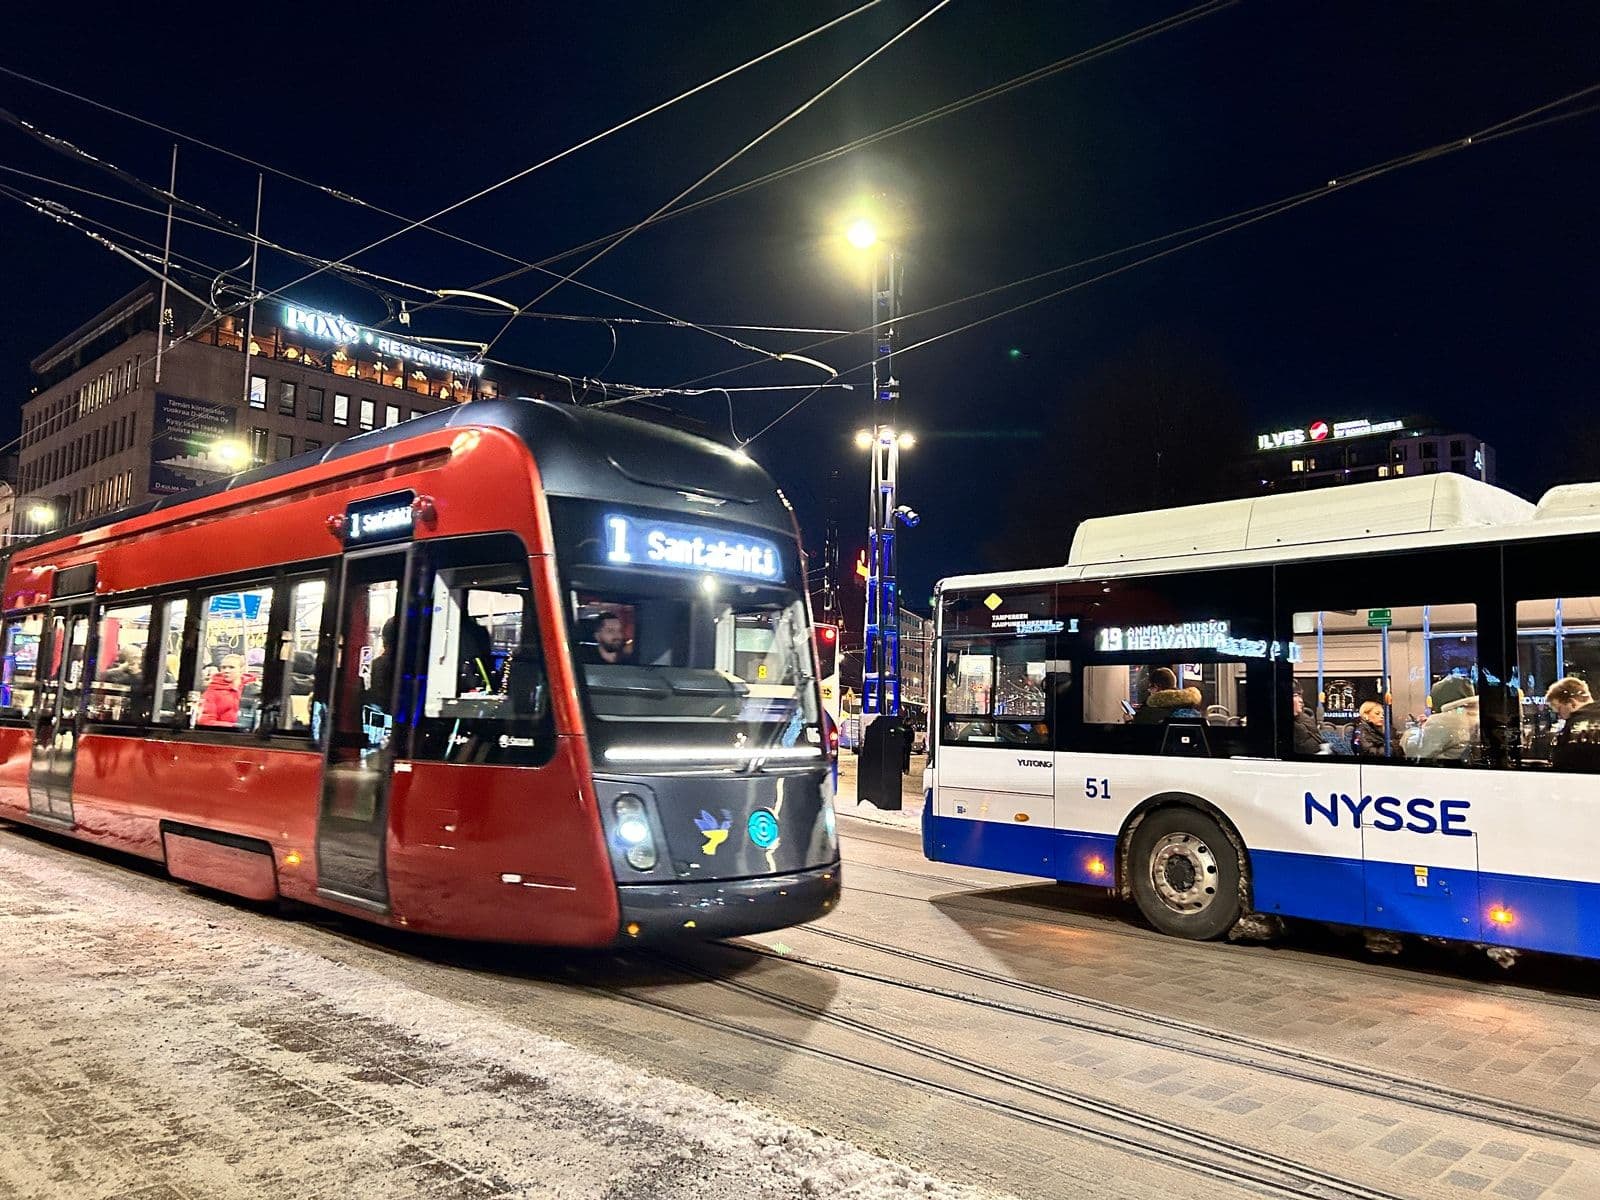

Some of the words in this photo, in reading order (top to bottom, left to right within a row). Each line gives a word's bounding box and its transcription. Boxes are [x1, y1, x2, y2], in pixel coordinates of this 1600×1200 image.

[378, 336, 485, 378] RESTAURANT
[1258, 429, 1306, 449] ILVES
[350, 513, 360, 537] 1
[608, 518, 631, 562] 1
[647, 530, 776, 576] Santalahti
[1127, 631, 1227, 650] HERVANTA
[1017, 759, 1053, 768] YUTONG
[1085, 778, 1111, 799] 51
[1305, 791, 1472, 837] NYSSE
